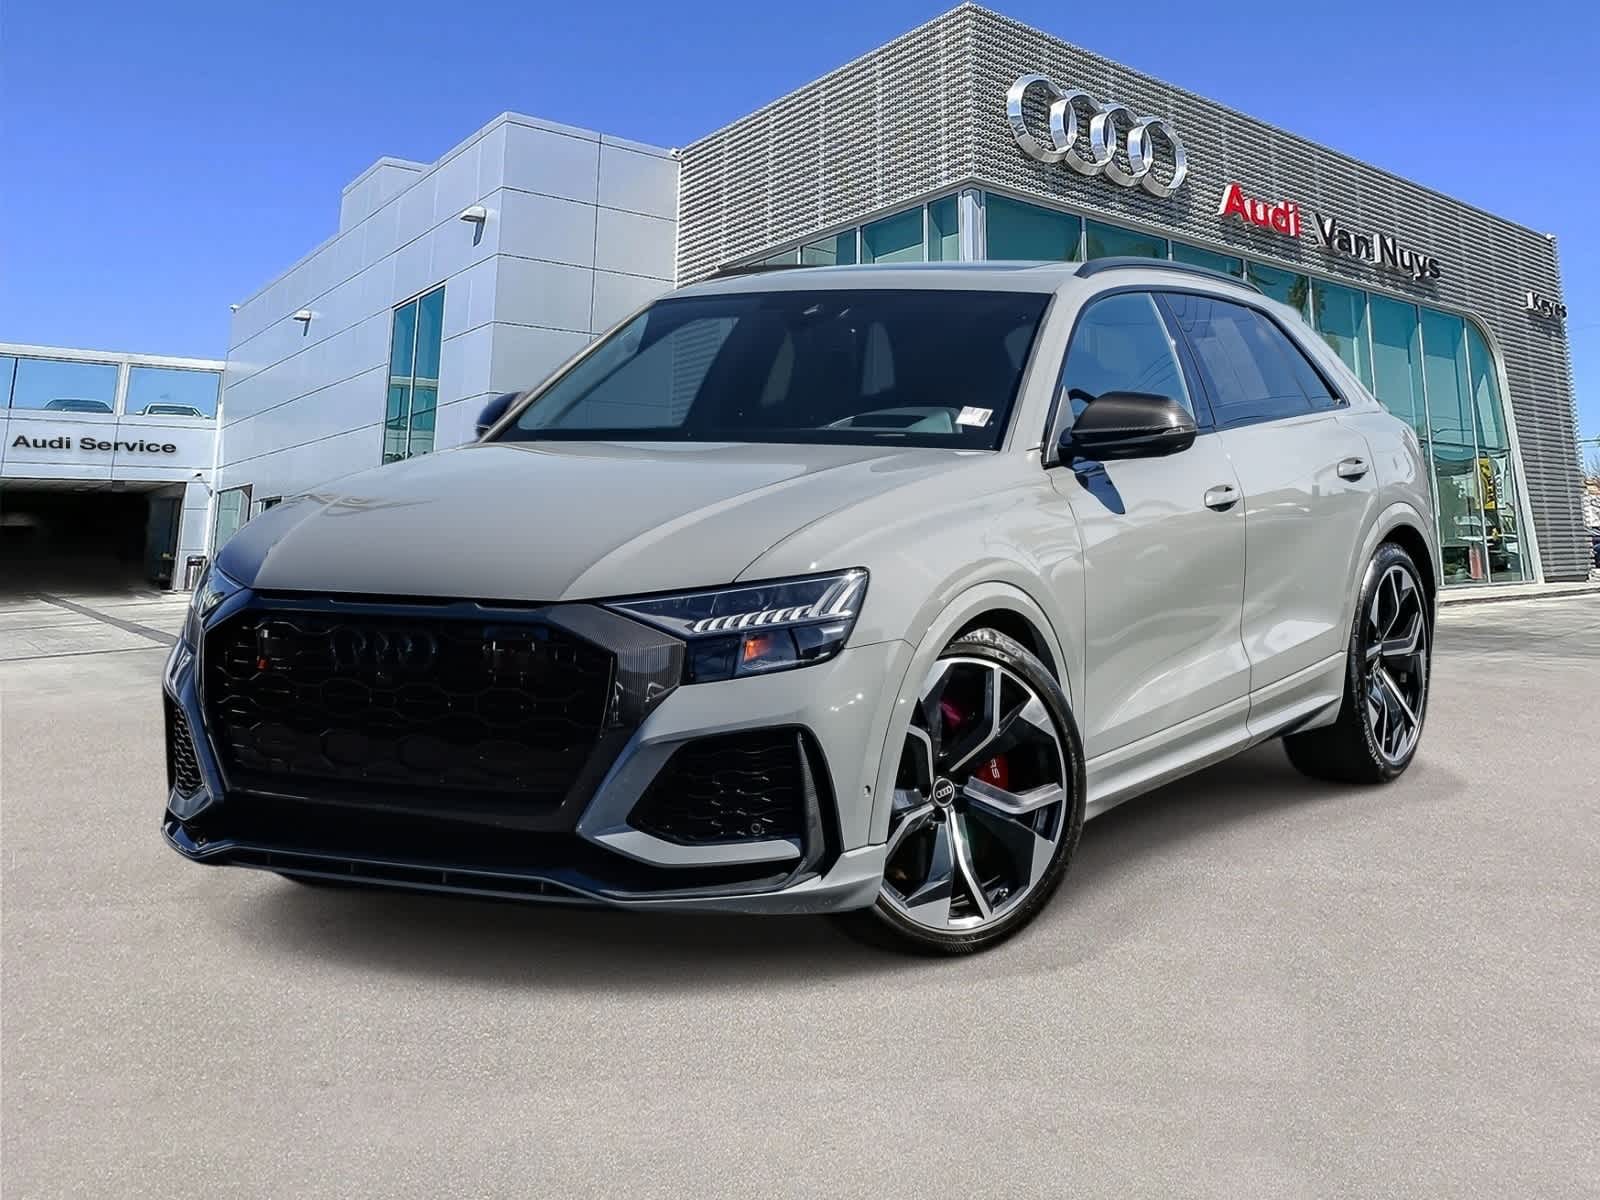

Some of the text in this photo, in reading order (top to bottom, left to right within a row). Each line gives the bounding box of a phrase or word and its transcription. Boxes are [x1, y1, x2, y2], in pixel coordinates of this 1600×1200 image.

[1218, 182, 1441, 280] Audi Van Nuys
[12, 435, 177, 453] Audi Service
